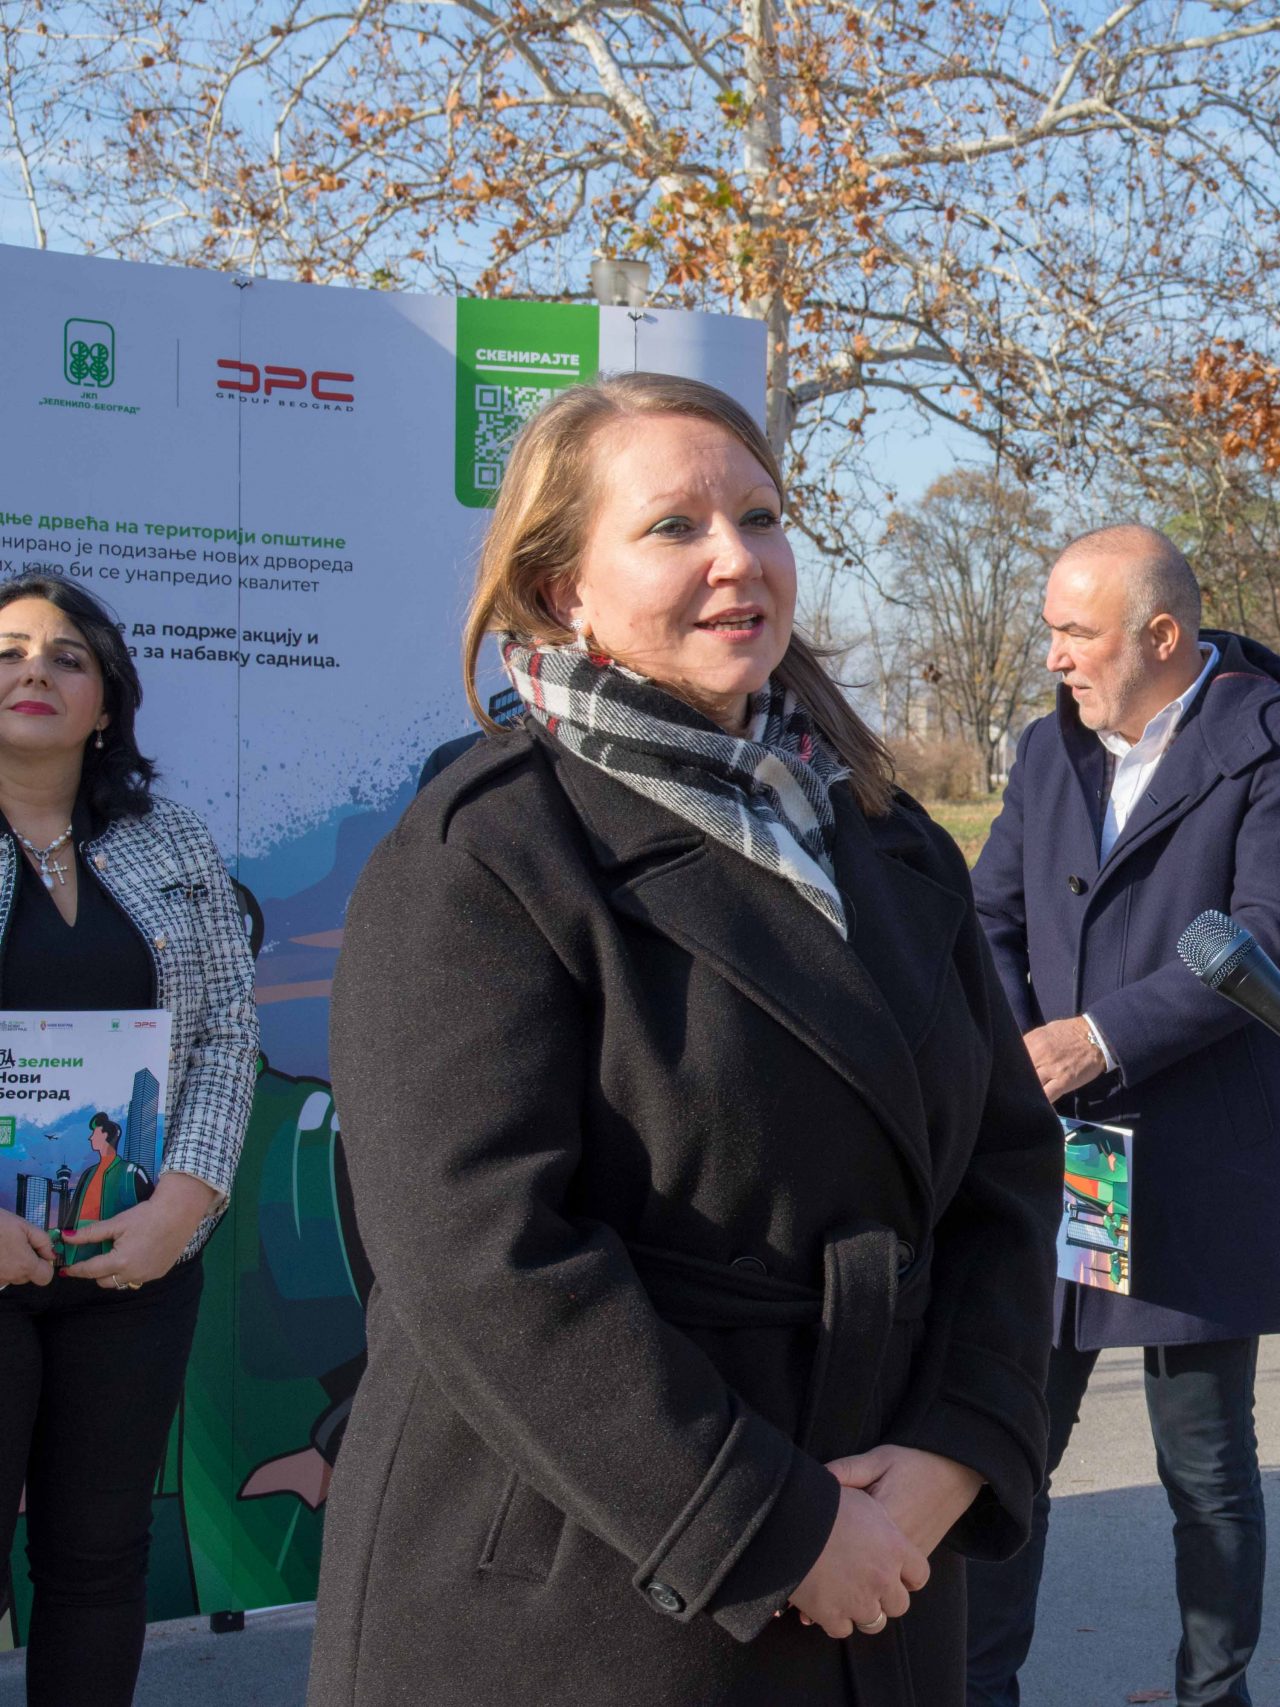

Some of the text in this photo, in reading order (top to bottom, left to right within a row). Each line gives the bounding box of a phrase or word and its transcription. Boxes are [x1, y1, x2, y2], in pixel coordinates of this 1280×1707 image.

[476, 349, 579, 366] СКЕНИРАЈТЕ
[216, 392, 355, 413] GROUP BEOGRAD
[38, 513, 109, 533] дрвећа
[116, 522, 138, 534] на
[144, 524, 256, 547] територији
[261, 533, 347, 550] општине
[76, 538, 93, 556] је
[99, 543, 198, 562] подизање
[203, 550, 259, 567] нових
[264, 556, 354, 574] дрвореда
[0, 559, 17, 574] х,
[70, 561, 93, 579] би
[99, 566, 120, 580] се
[125, 570, 232, 588] унапредио
[239, 576, 320, 593] квалитет
[132, 622, 156, 638] да
[162, 624, 237, 641] подрже
[242, 630, 302, 647] акцију
[307, 632, 319, 645] и
[144, 647, 165, 659] за
[170, 647, 250, 668] набавку
[256, 653, 341, 669] садница.
[18, 1056, 84, 1068] зелени
